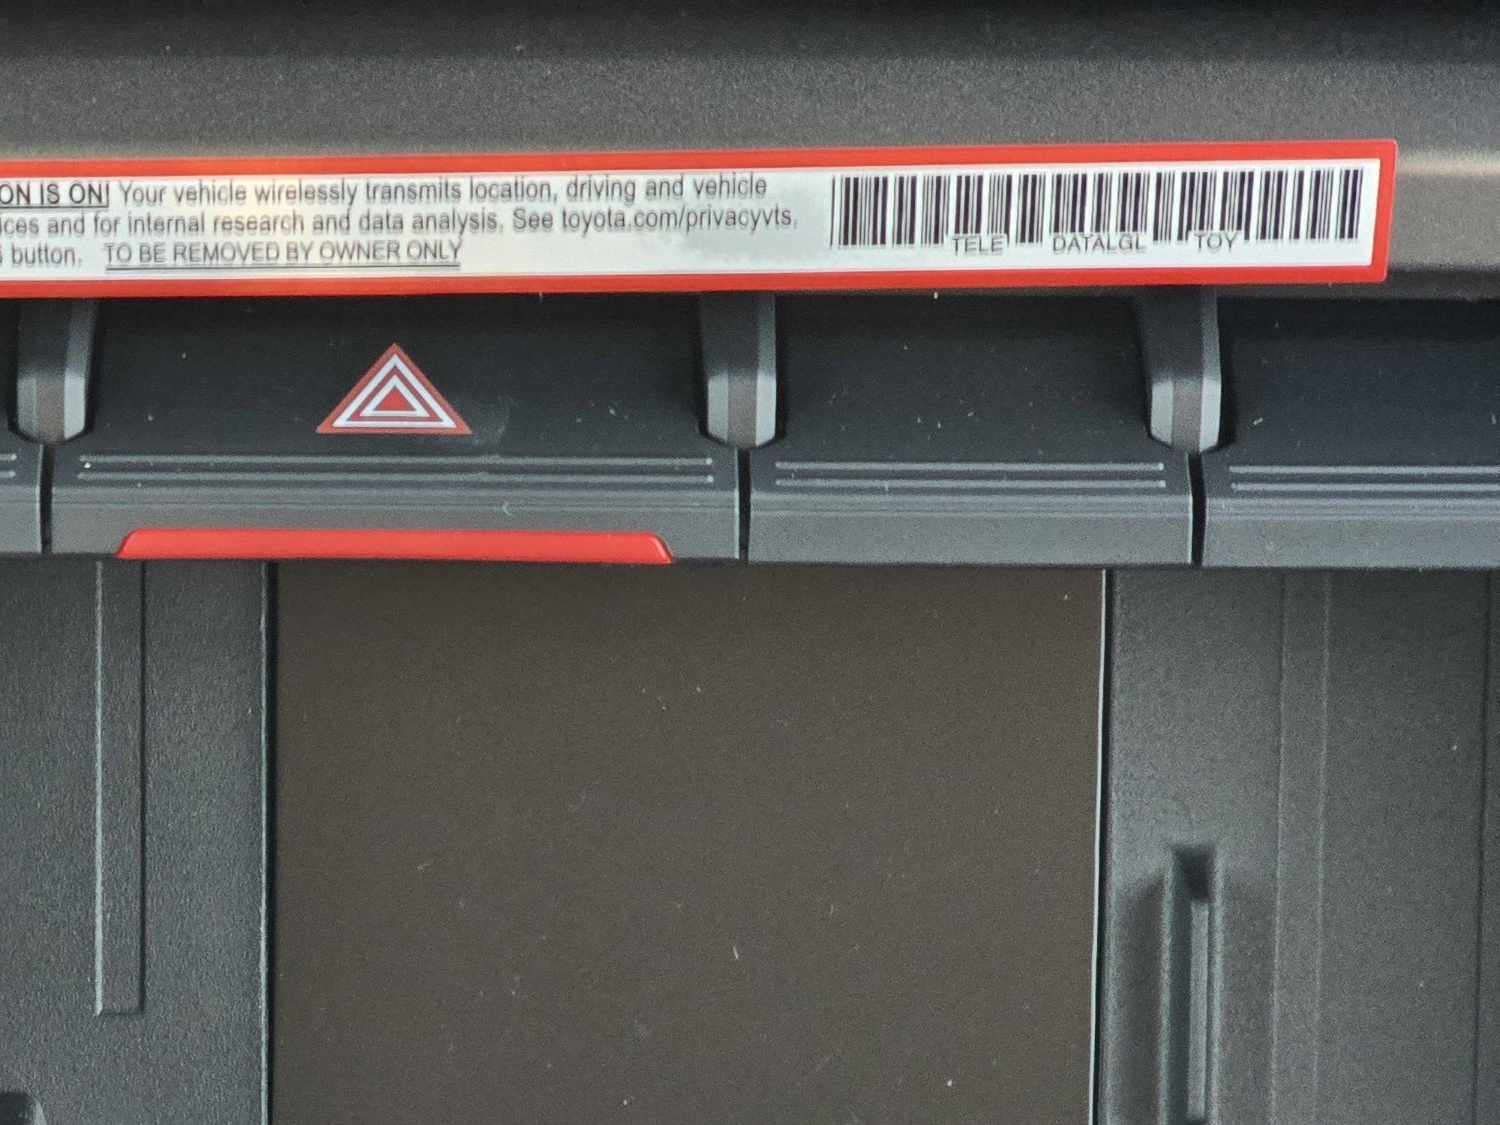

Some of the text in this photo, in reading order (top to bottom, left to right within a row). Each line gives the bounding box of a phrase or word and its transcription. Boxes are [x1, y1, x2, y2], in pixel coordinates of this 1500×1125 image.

[40, 183, 61, 206] IS
[69, 182, 109, 205] ON!
[117, 180, 167, 204] Your
[174, 179, 246, 202] vehicle
[254, 178, 356, 206] wirelessly
[366, 178, 461, 201] transmits
[469, 177, 558, 205] location,
[566, 175, 636, 202] driving
[645, 174, 684, 197] and
[693, 172, 767, 196] vehicle
[48, 211, 85, 235] and
[93, 211, 121, 235] for
[128, 211, 205, 234] internal
[213, 210, 304, 234] research
[313, 209, 350, 233] and
[359, 209, 403, 232] data
[412, 207, 503, 234] analysis.
[513, 208, 553, 231] See
[562, 203, 798, 236] toyota.com/privacyvts.
[12, 242, 82, 266] button.
[103, 243, 131, 264] TO
[139, 243, 166, 263] BE
[173, 241, 280, 263] REMOVED
[286, 241, 313, 263] BY
[320, 240, 400, 262] OWNER
[406, 239, 462, 261] ONLY
[952, 233, 1239, 253] TELE DATALGL TOY
